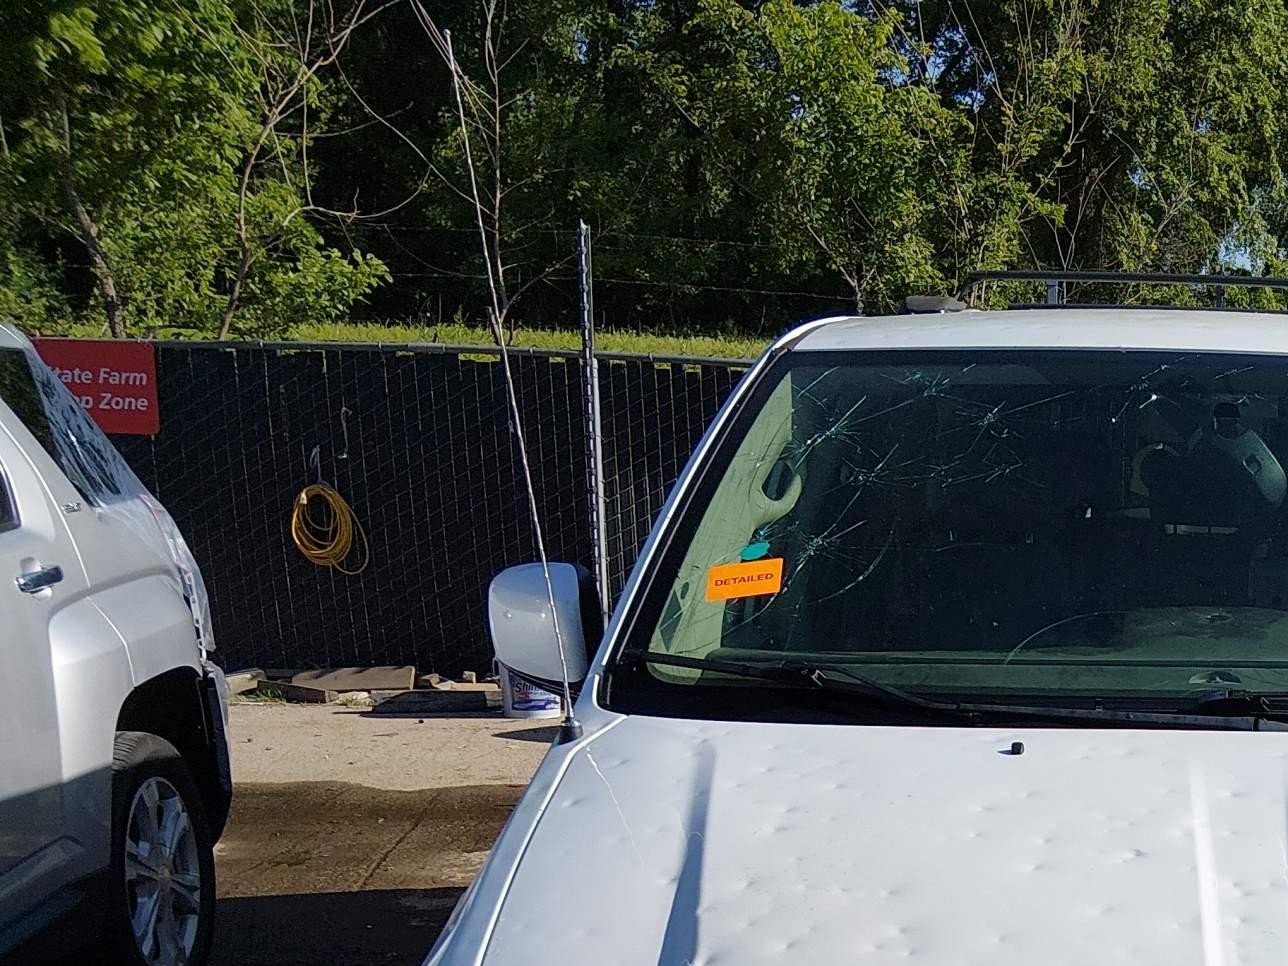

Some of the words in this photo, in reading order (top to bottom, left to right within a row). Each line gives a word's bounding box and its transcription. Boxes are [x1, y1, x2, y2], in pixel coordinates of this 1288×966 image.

[48, 366, 93, 384] tate
[98, 367, 148, 386] Farm
[98, 392, 149, 411] Zone
[714, 573, 774, 587] DETAILED
